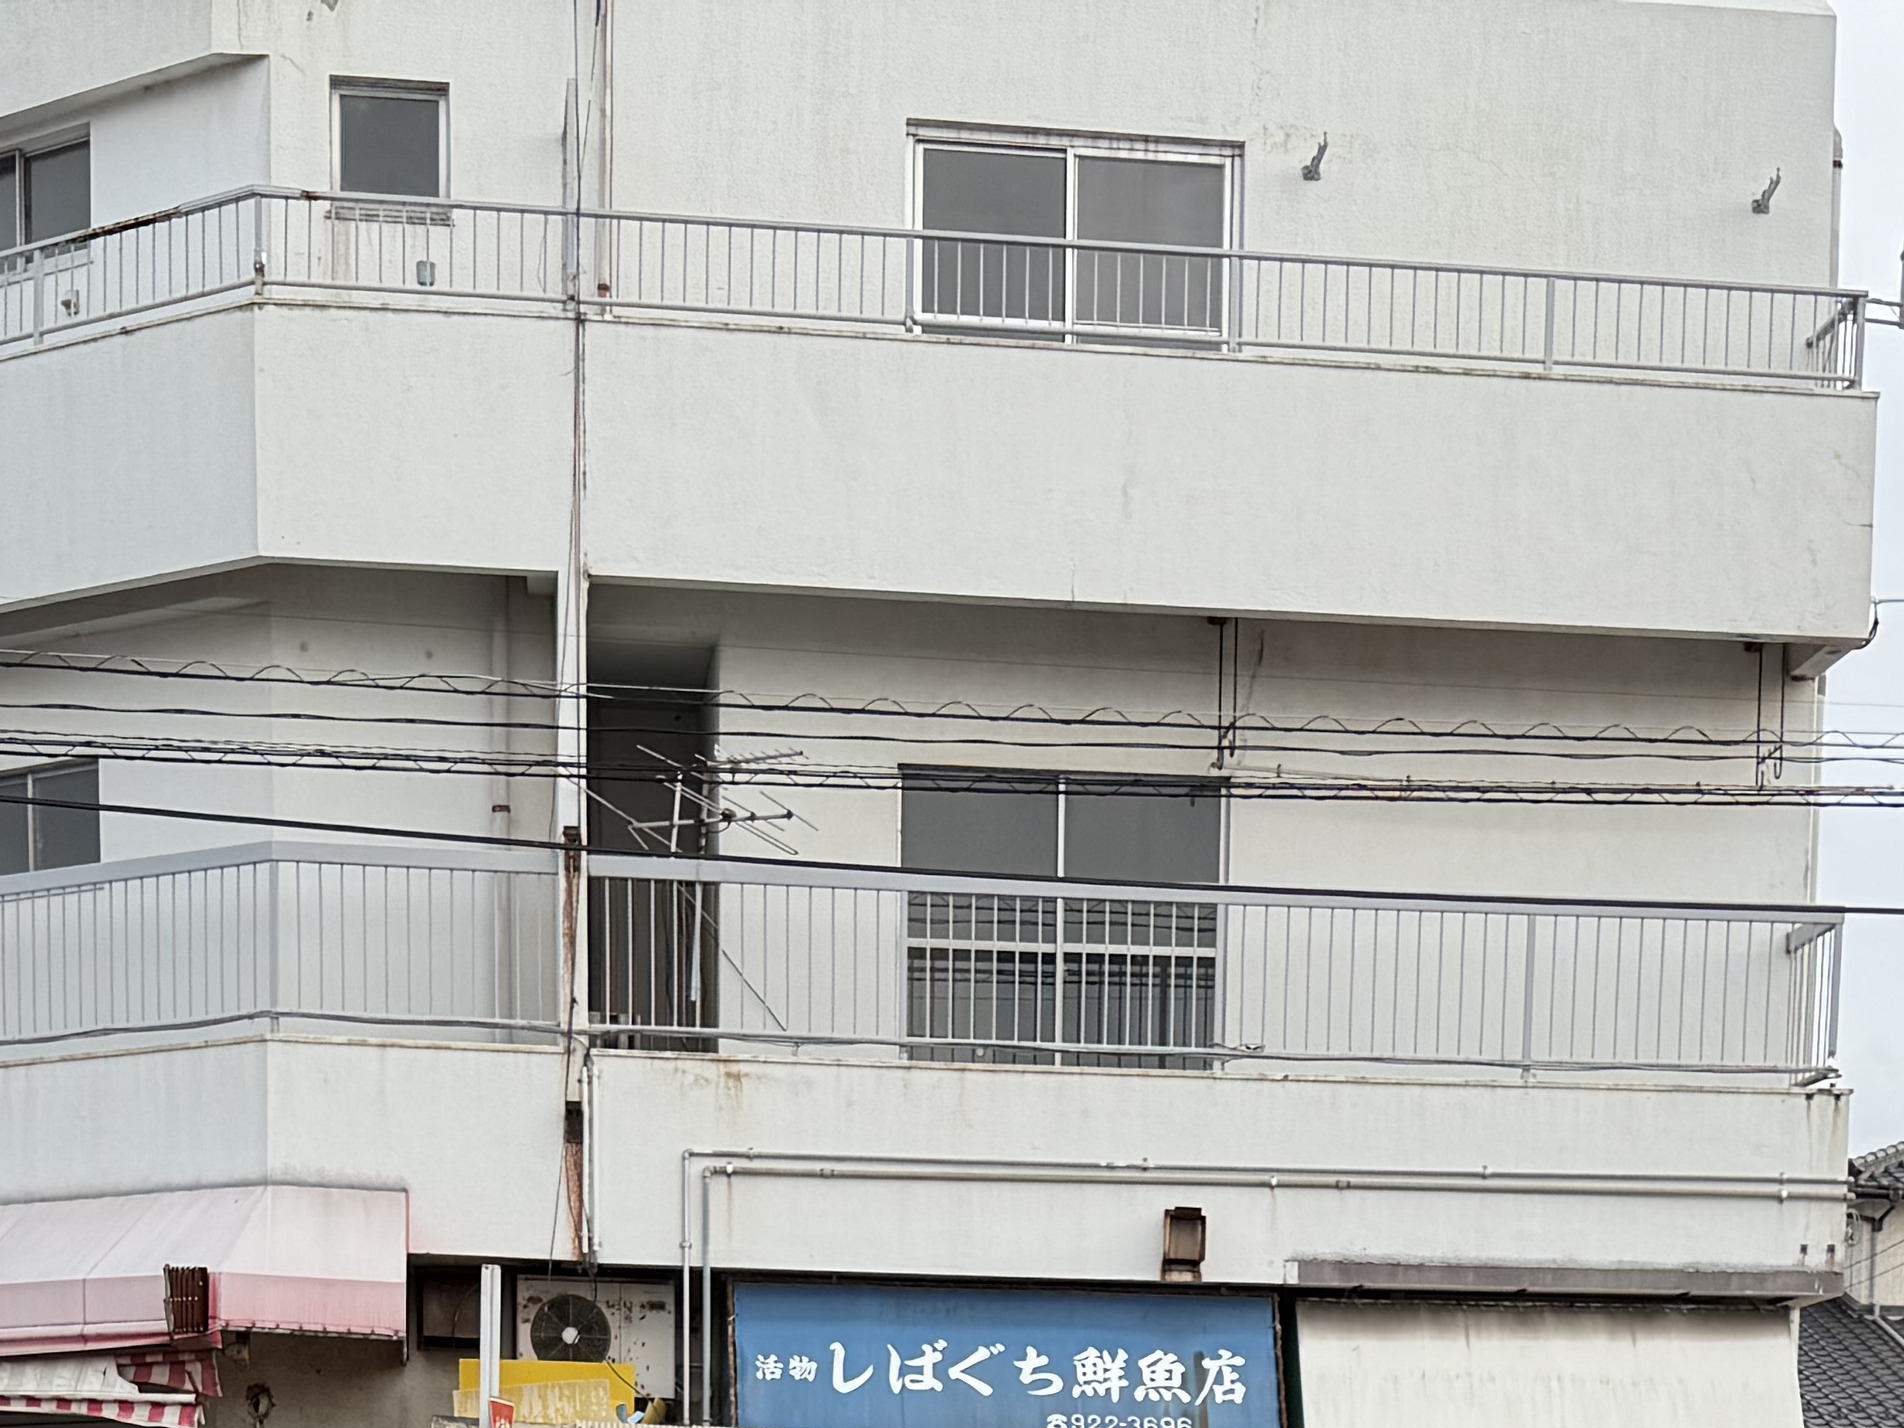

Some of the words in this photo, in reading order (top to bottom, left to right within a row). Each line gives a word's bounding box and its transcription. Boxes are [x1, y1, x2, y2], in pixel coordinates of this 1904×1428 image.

[755, 1354, 818, 1382] 活物
[829, 1339, 1247, 1406] しばぐち鮮魚店
